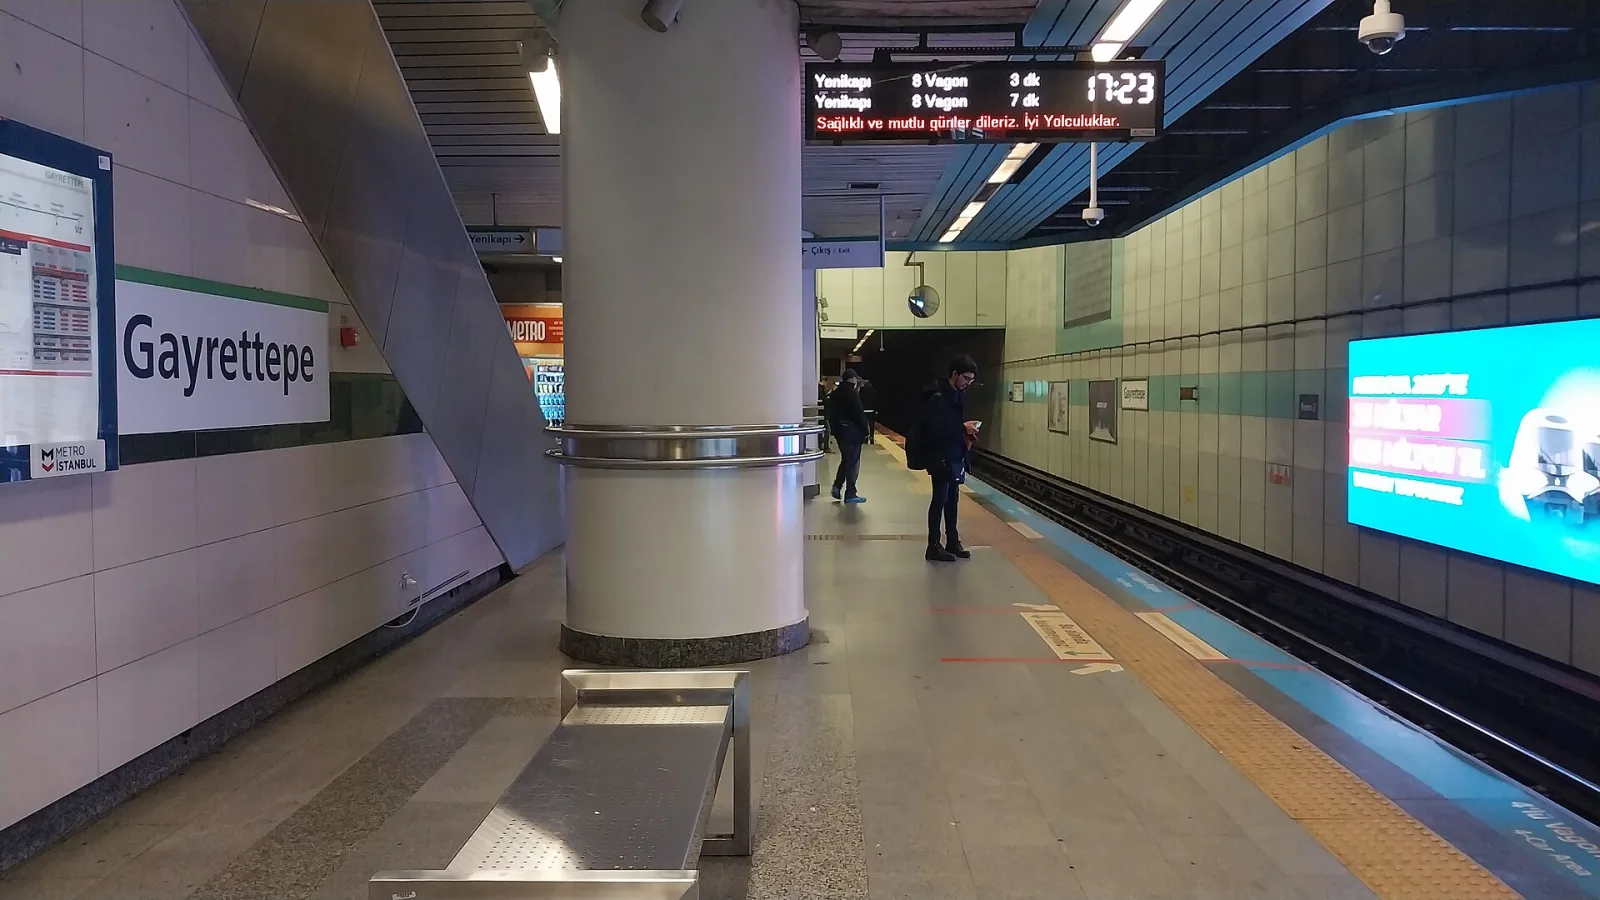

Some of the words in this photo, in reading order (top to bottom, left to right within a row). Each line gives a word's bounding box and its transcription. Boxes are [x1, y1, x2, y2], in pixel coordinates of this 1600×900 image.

[814, 73, 872, 91] Yenikapı
[912, 73, 922, 88] 8
[925, 73, 969, 91] Vagon
[1009, 72, 1020, 87] 3
[1023, 72, 1041, 87] dk
[1088, 72, 1155, 105] 17:23
[814, 94, 872, 112] Yenikapı
[912, 93, 922, 108] 8
[925, 93, 969, 112] Vagon
[1009, 93, 1020, 107] 7
[1022, 93, 1040, 107] dk
[816, 115, 864, 132] Sağlıklı
[868, 118, 884, 129] ve
[888, 116, 925, 129] mutlu
[930, 115, 972, 132] günler
[976, 114, 1020, 128] dileriz.
[1024, 112, 1039, 130] İyi
[1044, 113, 1120, 128] Yolculuklar.
[45, 170, 84, 188] GAYRETTEPE
[469, 234, 512, 246] Yenikapı
[811, 246, 831, 256] Çıkış
[123, 313, 314, 398] Gayrettepe
[56, 445, 86, 458] METRO
